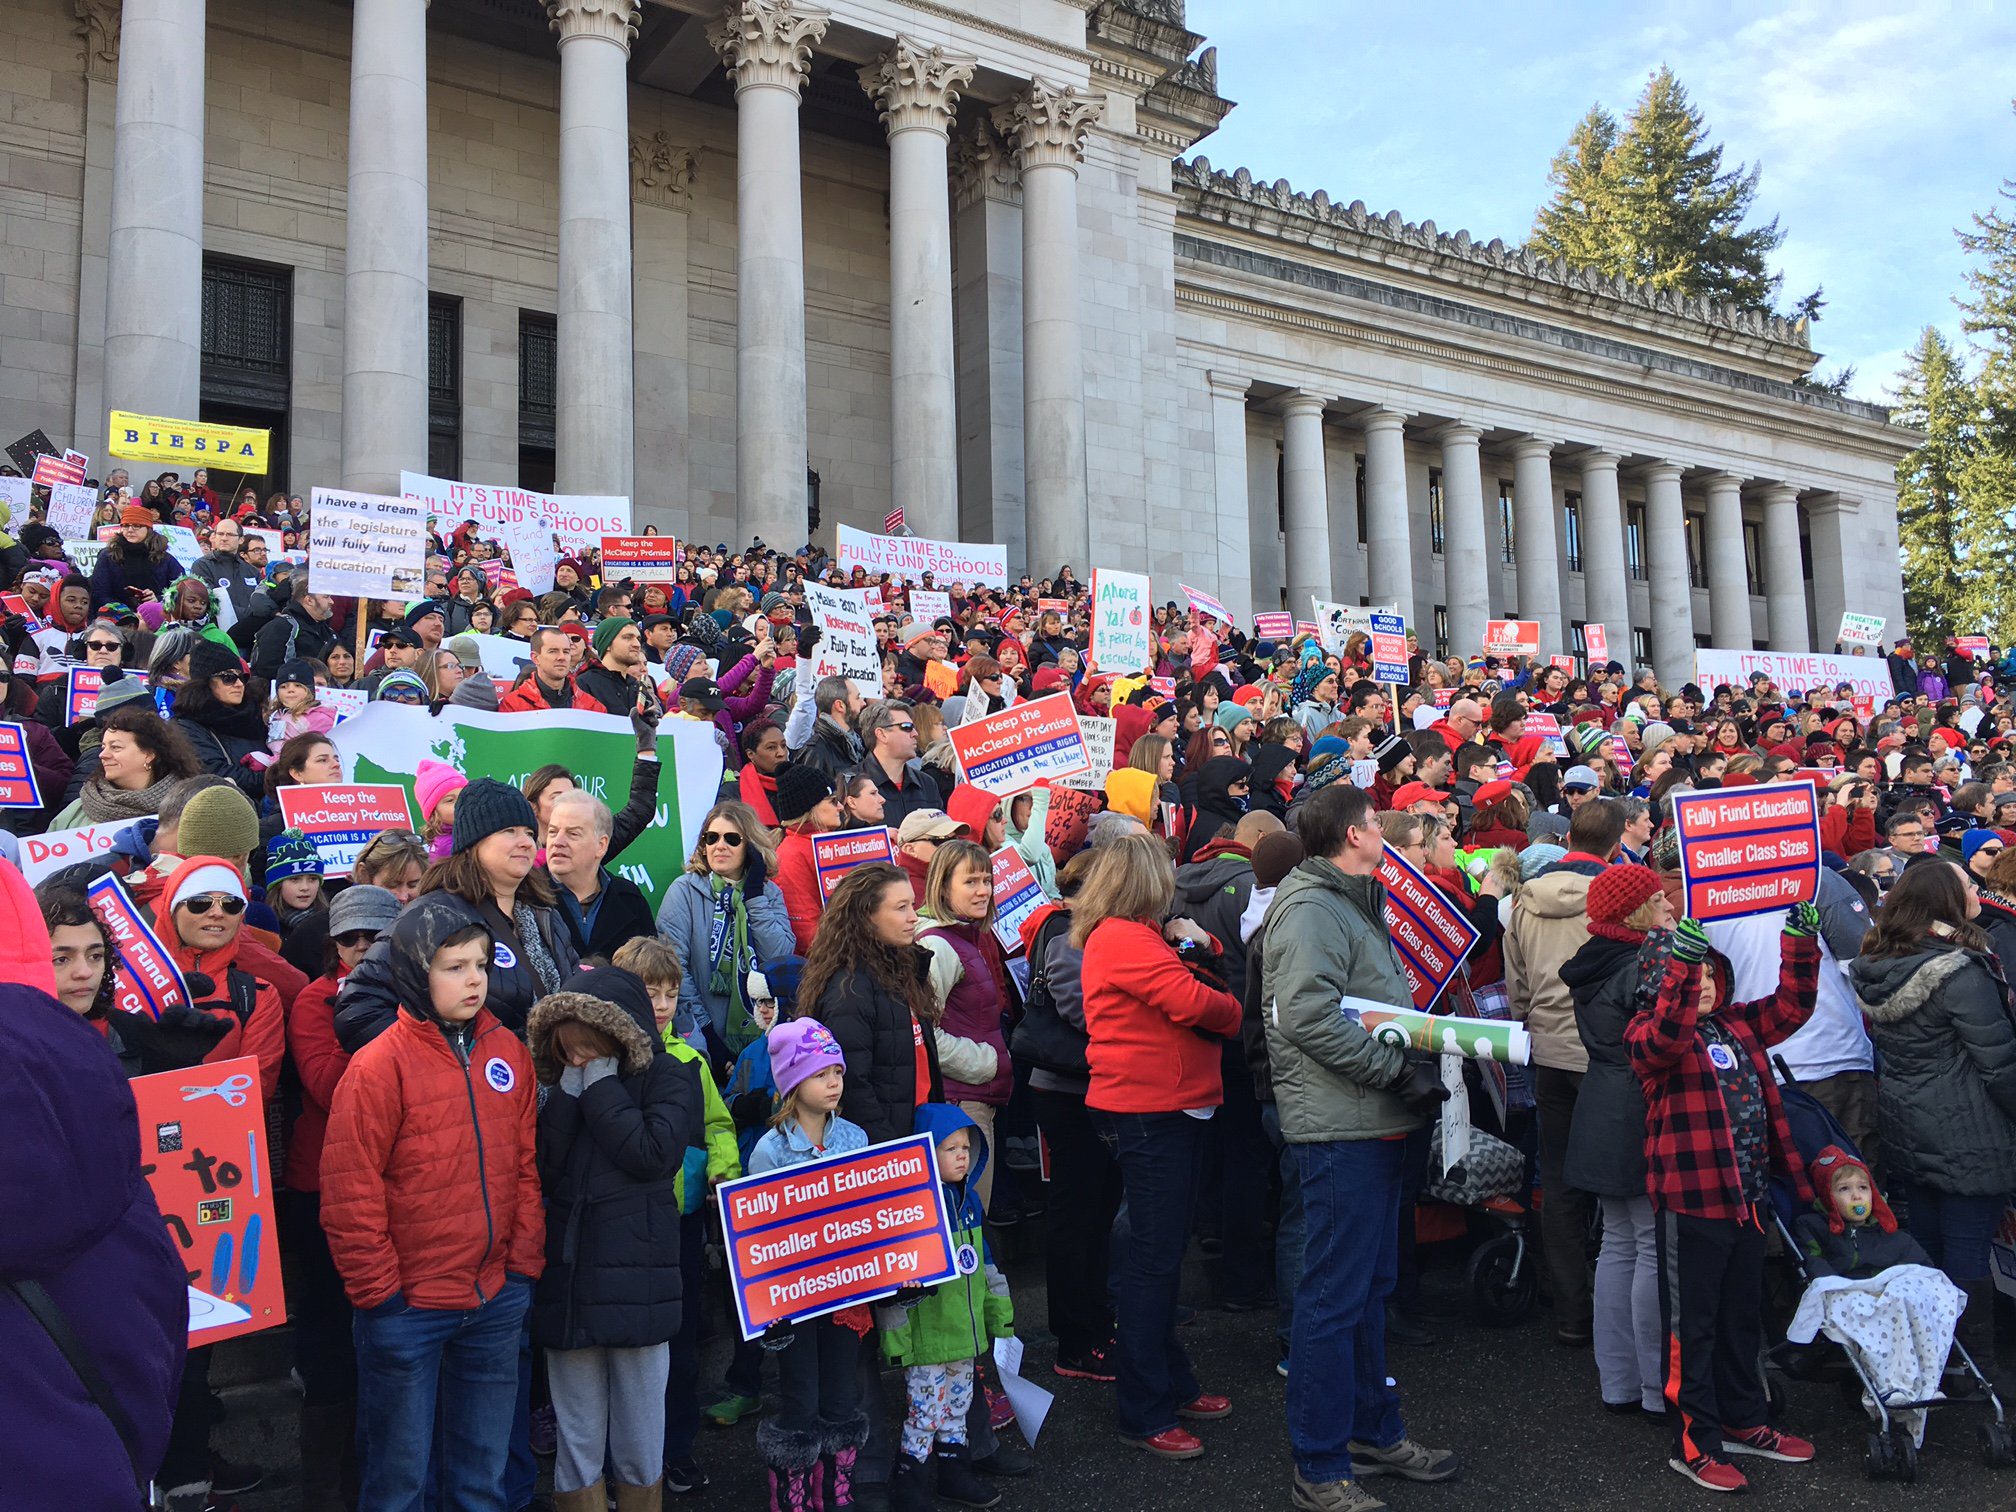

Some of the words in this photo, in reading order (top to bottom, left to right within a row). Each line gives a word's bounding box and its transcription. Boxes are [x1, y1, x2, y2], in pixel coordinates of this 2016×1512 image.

[325, 495, 357, 509] have
[361, 502, 369, 510] a
[450, 484, 487, 503] IT'S
[492, 489, 537, 510] TIME
[470, 503, 524, 523] FUND
[317, 516, 339, 529] the
[348, 519, 418, 537] legislature
[513, 527, 544, 543] Fund
[312, 537, 336, 548] will
[342, 538, 370, 554] fully
[377, 541, 407, 555] fund
[604, 549, 639, 558] McCleary
[640, 549, 671, 557] Promise
[620, 540, 639, 549] Keep
[870, 536, 898, 552] IT'S
[315, 558, 387, 575] education!
[840, 544, 881, 564] FULLY
[886, 553, 924, 571] FUND
[928, 559, 1007, 577] SCHOOLS.
[1105, 607, 1126, 628] Ya!
[1378, 616, 1397, 625] GOOD
[1373, 623, 1403, 633] SCHOOLS
[1842, 628, 1866, 640] CIVIL
[830, 635, 849, 658] Fully
[850, 639, 867, 657] Fund
[1108, 630, 1133, 649] para
[1135, 631, 1147, 650] los
[1375, 637, 1403, 646] REQUIRE
[1380, 644, 1399, 653] GOOD
[1493, 634, 1517, 643] TIME
[1099, 650, 1142, 669] escuelas
[1375, 663, 1389, 671] FUND
[1390, 664, 1408, 674] PUBLIC
[1740, 655, 1773, 674] IT'S
[1776, 656, 1819, 675] TIME
[817, 660, 838, 676] Arts
[841, 662, 877, 682] Education
[1380, 672, 1405, 681] SCHOOLS
[1812, 676, 1891, 698] SCOOLS
[985, 717, 1019, 735] Keep
[1020, 708, 1042, 724] the
[1100, 721, 1112, 733] DAY
[963, 731, 1023, 761] McCleary
[1024, 717, 1073, 740] Promise
[969, 756, 1015, 779] EDUCATION
[1016, 752, 1026, 763] IS
[1027, 749, 1035, 759] A
[1036, 742, 1056, 757] CIVIL
[1056, 735, 1079, 749] RIGHT
[1020, 764, 1031, 775] in
[1033, 756, 1049, 770] the
[321, 791, 356, 807] Keep
[356, 791, 377, 804] the
[293, 810, 359, 826] McCleary
[359, 809, 406, 823] Promise
[1685, 807, 1717, 828] Fully
[1719, 802, 1751, 823] Fund
[1752, 797, 1809, 819] Education
[26, 839, 69, 864] Do
[75, 828, 113, 853] Yo
[350, 833, 359, 842] IS
[361, 832, 368, 841] A
[818, 843, 834, 861] Fully
[834, 842, 851, 857] Fund
[851, 839, 886, 854] Education
[1695, 846, 1743, 870] Smaller
[1745, 843, 1778, 862] Class
[1779, 839, 1810, 858] Sizes
[291, 861, 317, 874] 12
[1707, 879, 1779, 908] Professional
[1781, 877, 1802, 897] Pay
[1400, 878, 1428, 911] Fund
[1424, 900, 1466, 950] Education
[97, 895, 135, 942] Fully
[130, 941, 171, 990] Fund
[1398, 922, 1423, 952] Class
[1420, 944, 1444, 974] Sizes
[1406, 971, 1422, 995] Pay
[182, 1147, 243, 1194] to
[735, 1191, 779, 1220] Fully
[783, 1175, 830, 1206] Fund
[833, 1156, 923, 1193] Education
[200, 1206, 229, 1223] DAY
[749, 1231, 819, 1267] Smaller
[822, 1217, 873, 1245] Class
[876, 1204, 926, 1231] Sizes
[769, 1255, 881, 1308] Professional
[884, 1249, 919, 1275] Pay
